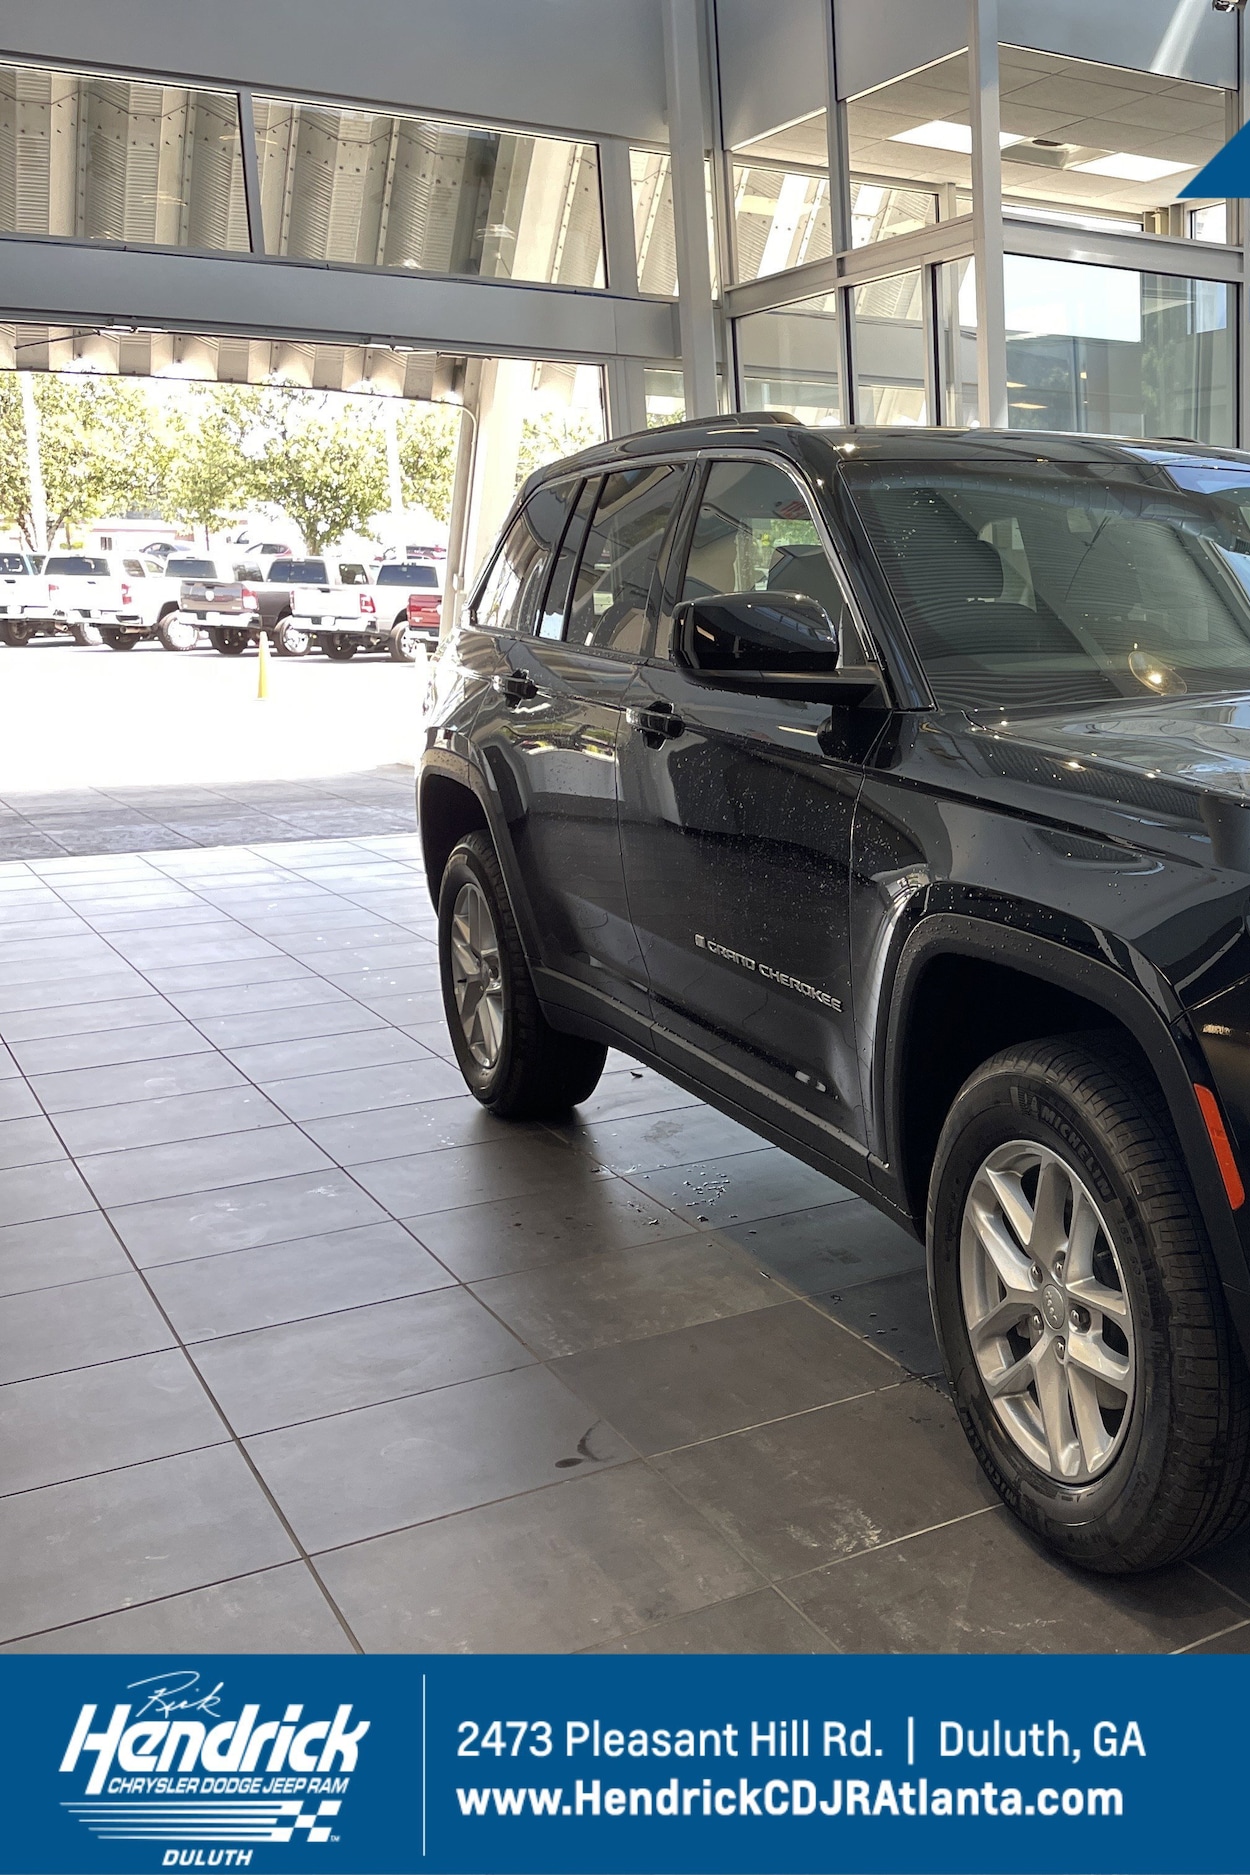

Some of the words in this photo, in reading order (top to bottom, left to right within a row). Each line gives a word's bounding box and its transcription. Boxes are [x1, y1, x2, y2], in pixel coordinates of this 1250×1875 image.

[707, 940, 756, 971] GRAND
[759, 963, 843, 1013] CHEROKEE
[1040, 1108, 1112, 1198] MICHELIN
